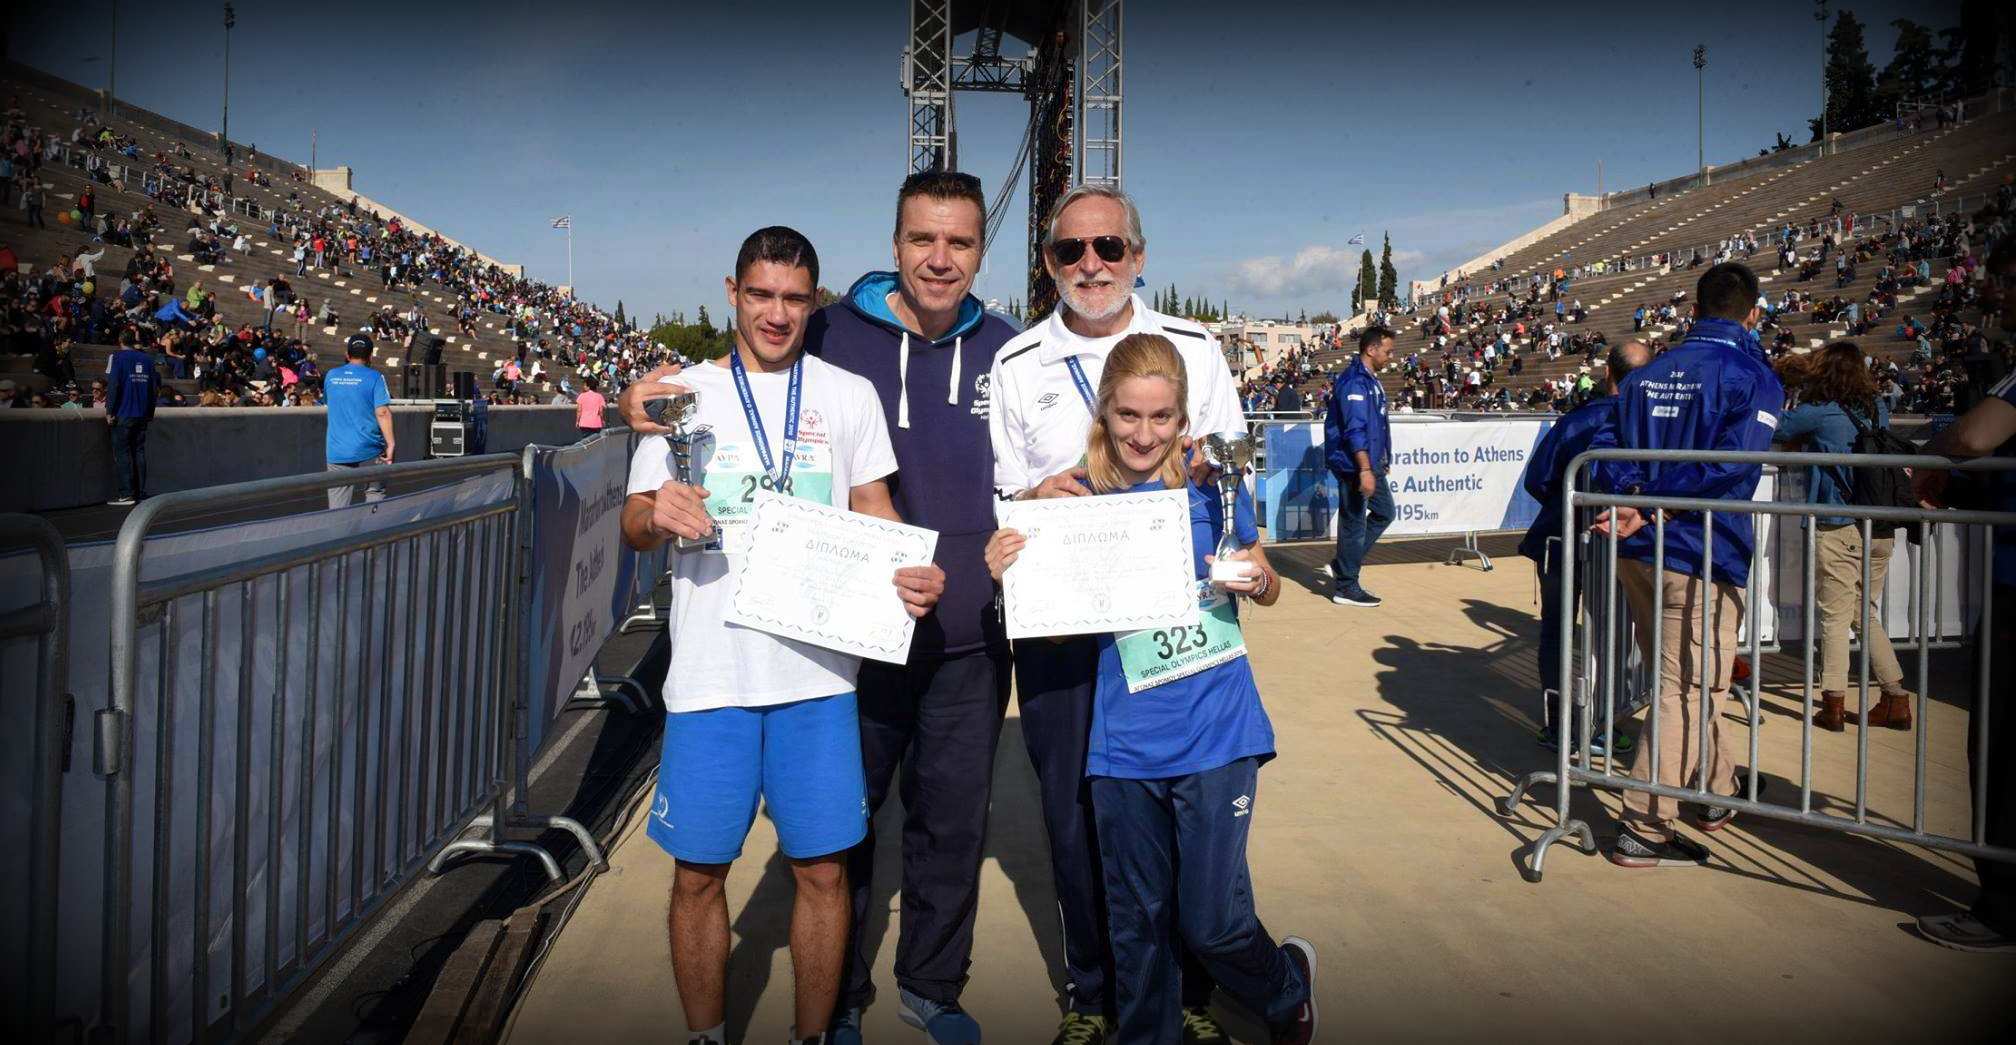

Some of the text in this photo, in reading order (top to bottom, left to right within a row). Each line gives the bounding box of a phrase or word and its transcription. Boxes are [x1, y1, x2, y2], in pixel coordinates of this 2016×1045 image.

[1393, 446, 1524, 465] rathon to Athens
[1403, 473, 1483, 493] Authentic
[718, 506, 748, 515] SPECIAL
[1063, 530, 1131, 545] ΔΙΠΛΩΜΑ
[1152, 622, 1208, 660] 323
[1140, 641, 1232, 679] SPECIAL OLYMPICS HELLAS
